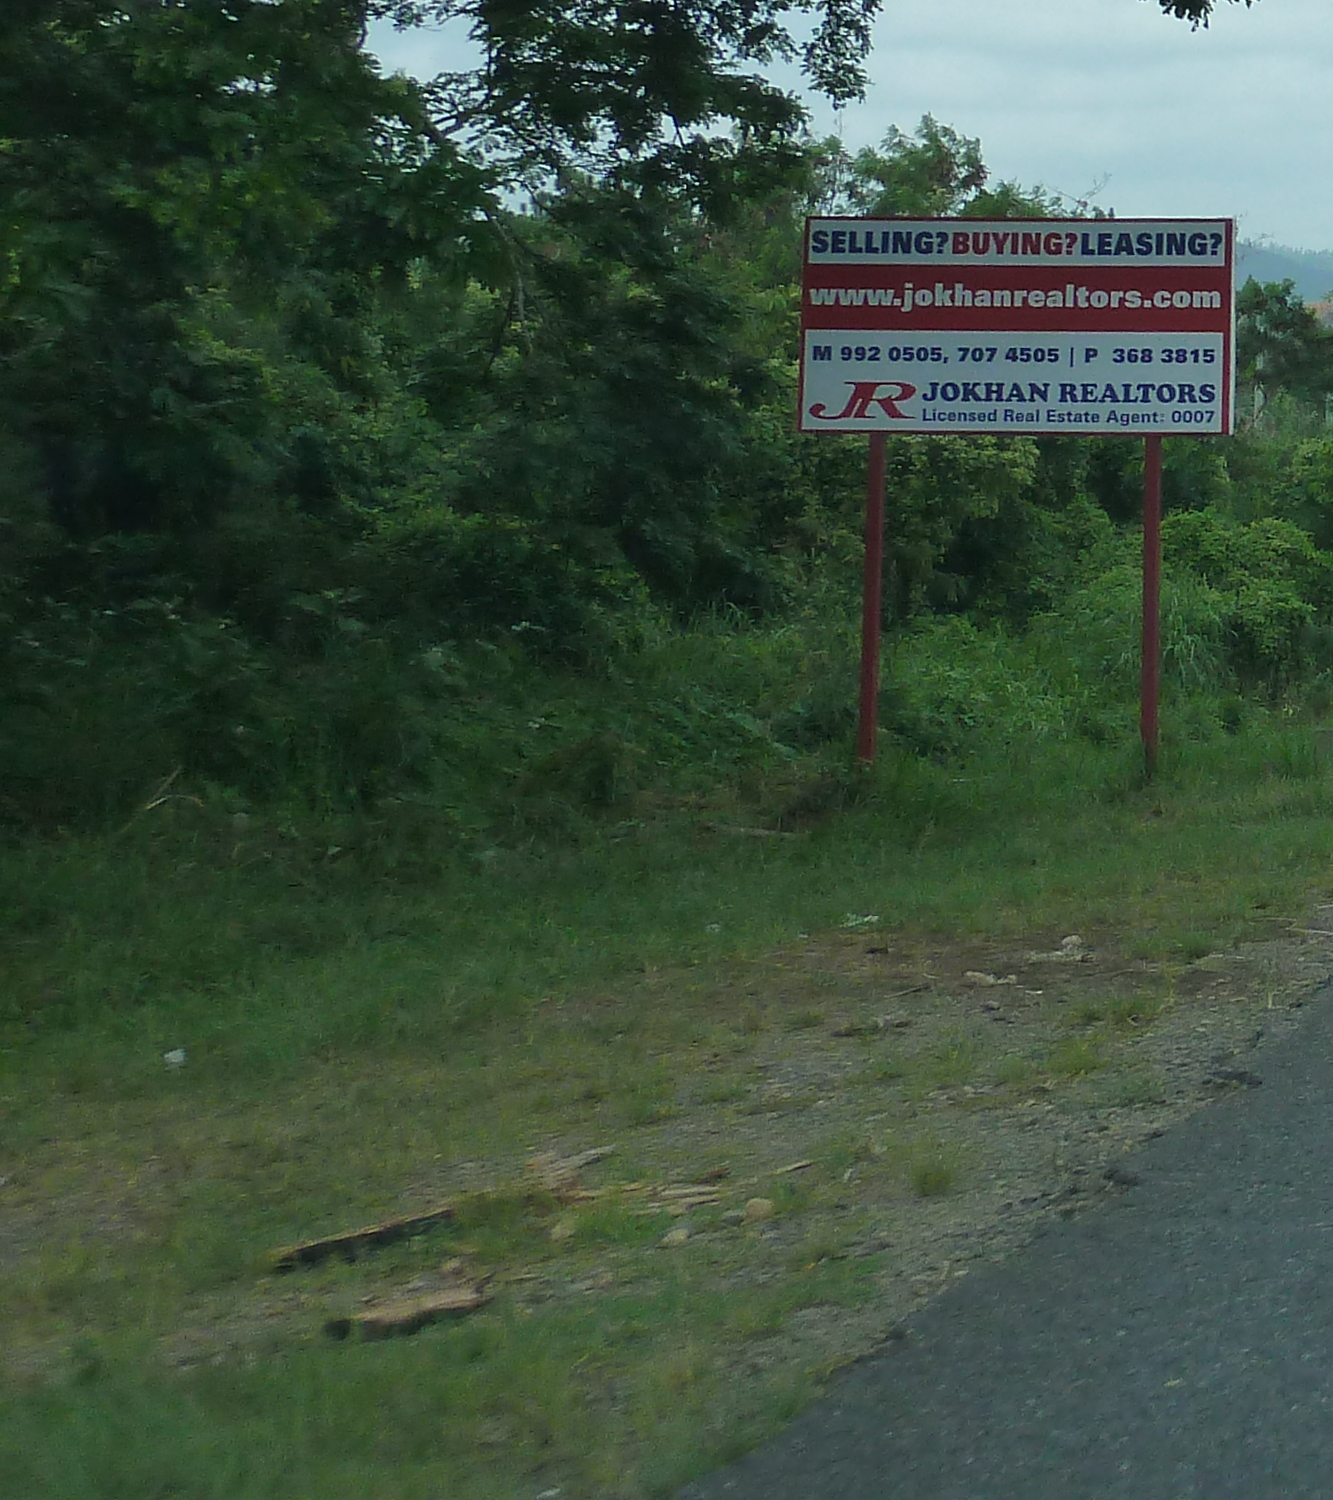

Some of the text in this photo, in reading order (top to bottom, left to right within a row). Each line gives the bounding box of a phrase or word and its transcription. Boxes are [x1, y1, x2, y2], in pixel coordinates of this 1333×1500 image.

[812, 230, 1222, 256] SELLING? BUYING? LEASING?
[810, 282, 1221, 312] www.jokhanrealtors.com
[813, 346, 832, 361] M
[840, 346, 880, 361] 992
[888, 346, 949, 364] 0505,
[958, 347, 998, 362] 707
[1005, 348, 1059, 362] 4505
[1084, 348, 1098, 363] P
[1112, 349, 1153, 363] 368
[1161, 349, 1215, 364] 3815
[810, 381, 916, 420] JR
[922, 382, 1215, 404] JOKHAN REALTORS
[922, 409, 997, 423] Licensed
[1004, 409, 1040, 423] Real
[1047, 409, 1100, 423] Estate
[1171, 410, 1215, 423] 0007
